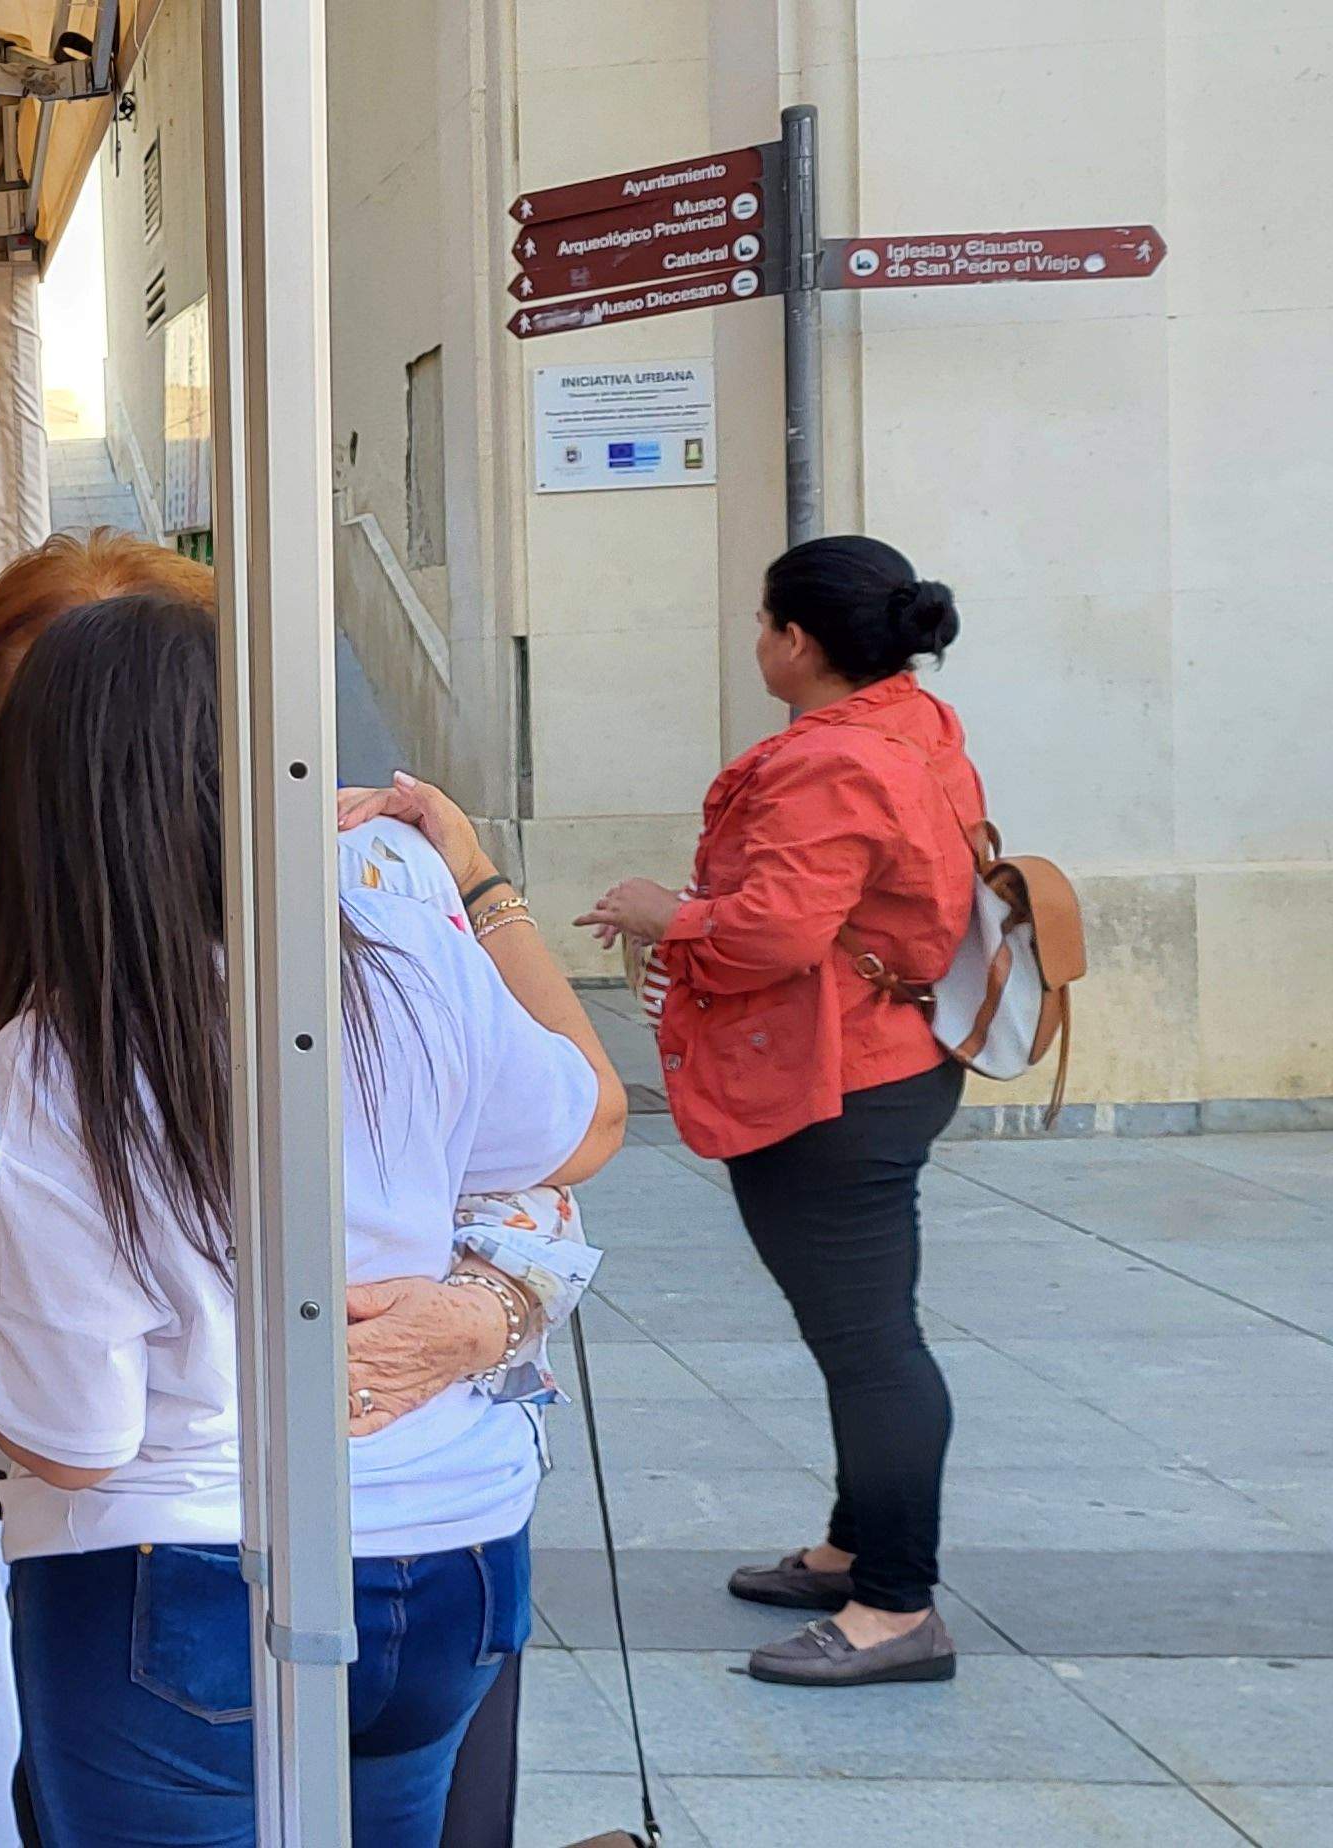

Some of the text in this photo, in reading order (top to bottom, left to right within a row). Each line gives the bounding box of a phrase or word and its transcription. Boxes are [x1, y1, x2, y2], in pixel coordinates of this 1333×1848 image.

[621, 163, 727, 197] Ayuntamiento
[673, 197, 726, 216] Museo
[556, 214, 727, 258] Arqueológico Provincial
[662, 245, 728, 269] Catedral
[886, 239, 1044, 261] Iglesia y Claustro
[885, 255, 1081, 278] de San Pedro el Viejo
[593, 281, 727, 317] Museo Diocesano
[561, 370, 695, 388] INICIATIVA URBANA
